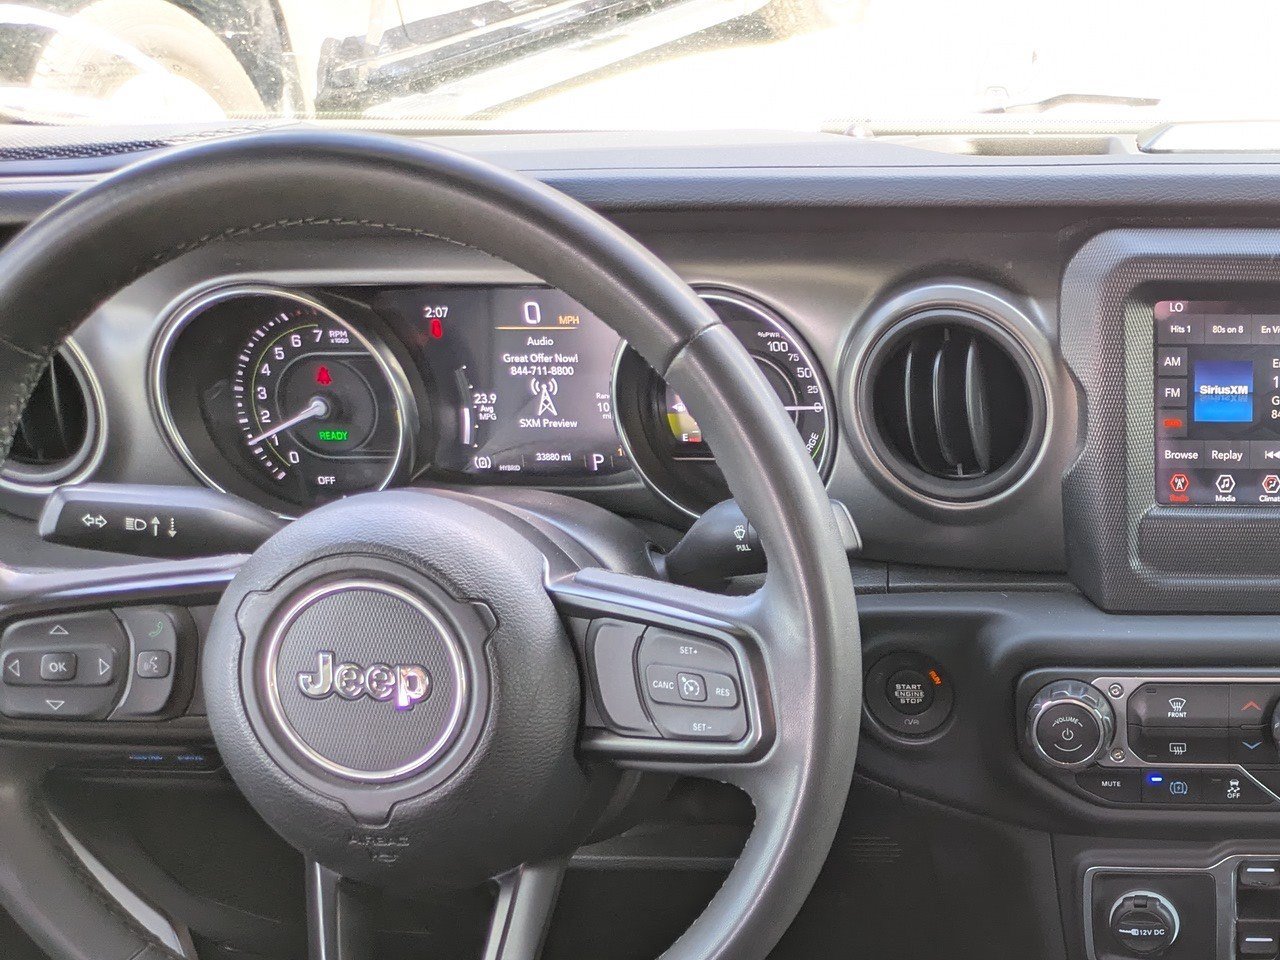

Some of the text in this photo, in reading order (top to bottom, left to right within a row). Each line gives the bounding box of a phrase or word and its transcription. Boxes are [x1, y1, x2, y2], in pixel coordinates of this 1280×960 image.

[1169, 303, 1184, 312] LO
[425, 307, 449, 319] 2:07
[558, 315, 580, 325] MPH
[1170, 325, 1185, 334] Hits
[1212, 325, 1226, 333] 80s
[1238, 325, 1244, 333] 8
[1261, 326, 1271, 334] En
[291, 334, 302, 347] 6
[313, 330, 323, 343] 7
[527, 337, 554, 346] Audio
[767, 342, 788, 352] 100
[275, 347, 285, 360] 5
[503, 354, 578, 363] Great Offer Now!
[788, 353, 799, 361] 75
[1164, 357, 1181, 366] AM
[261, 363, 272, 376] 4
[510, 366, 574, 376] 844-711-8800
[797, 367, 812, 378] 50
[1273, 376, 1279, 388] 1
[257, 387, 267, 400] 3
[1165, 388, 1180, 398] FM
[1200, 386, 1248, 395] SiriusXM
[474, 394, 497, 404] 23.9
[480, 405, 494, 414] Avg
[260, 410, 271, 423] 2
[479, 413, 497, 421] MPG
[520, 419, 577, 428] SXM Preview
[272, 434, 279, 446] 1
[319, 431, 348, 440] READY
[289, 451, 300, 463] 0
[536, 453, 572, 462] 33880 mi
[1164, 450, 1198, 459] Browse
[1212, 450, 1243, 461] Replay
[593, 454, 604, 471] P
[317, 476, 336, 485] OFF
[50, 662, 66, 672] OK
[299, 650, 432, 710] Jeep
[653, 680, 674, 689] CANC
[715, 688, 730, 696] RES
